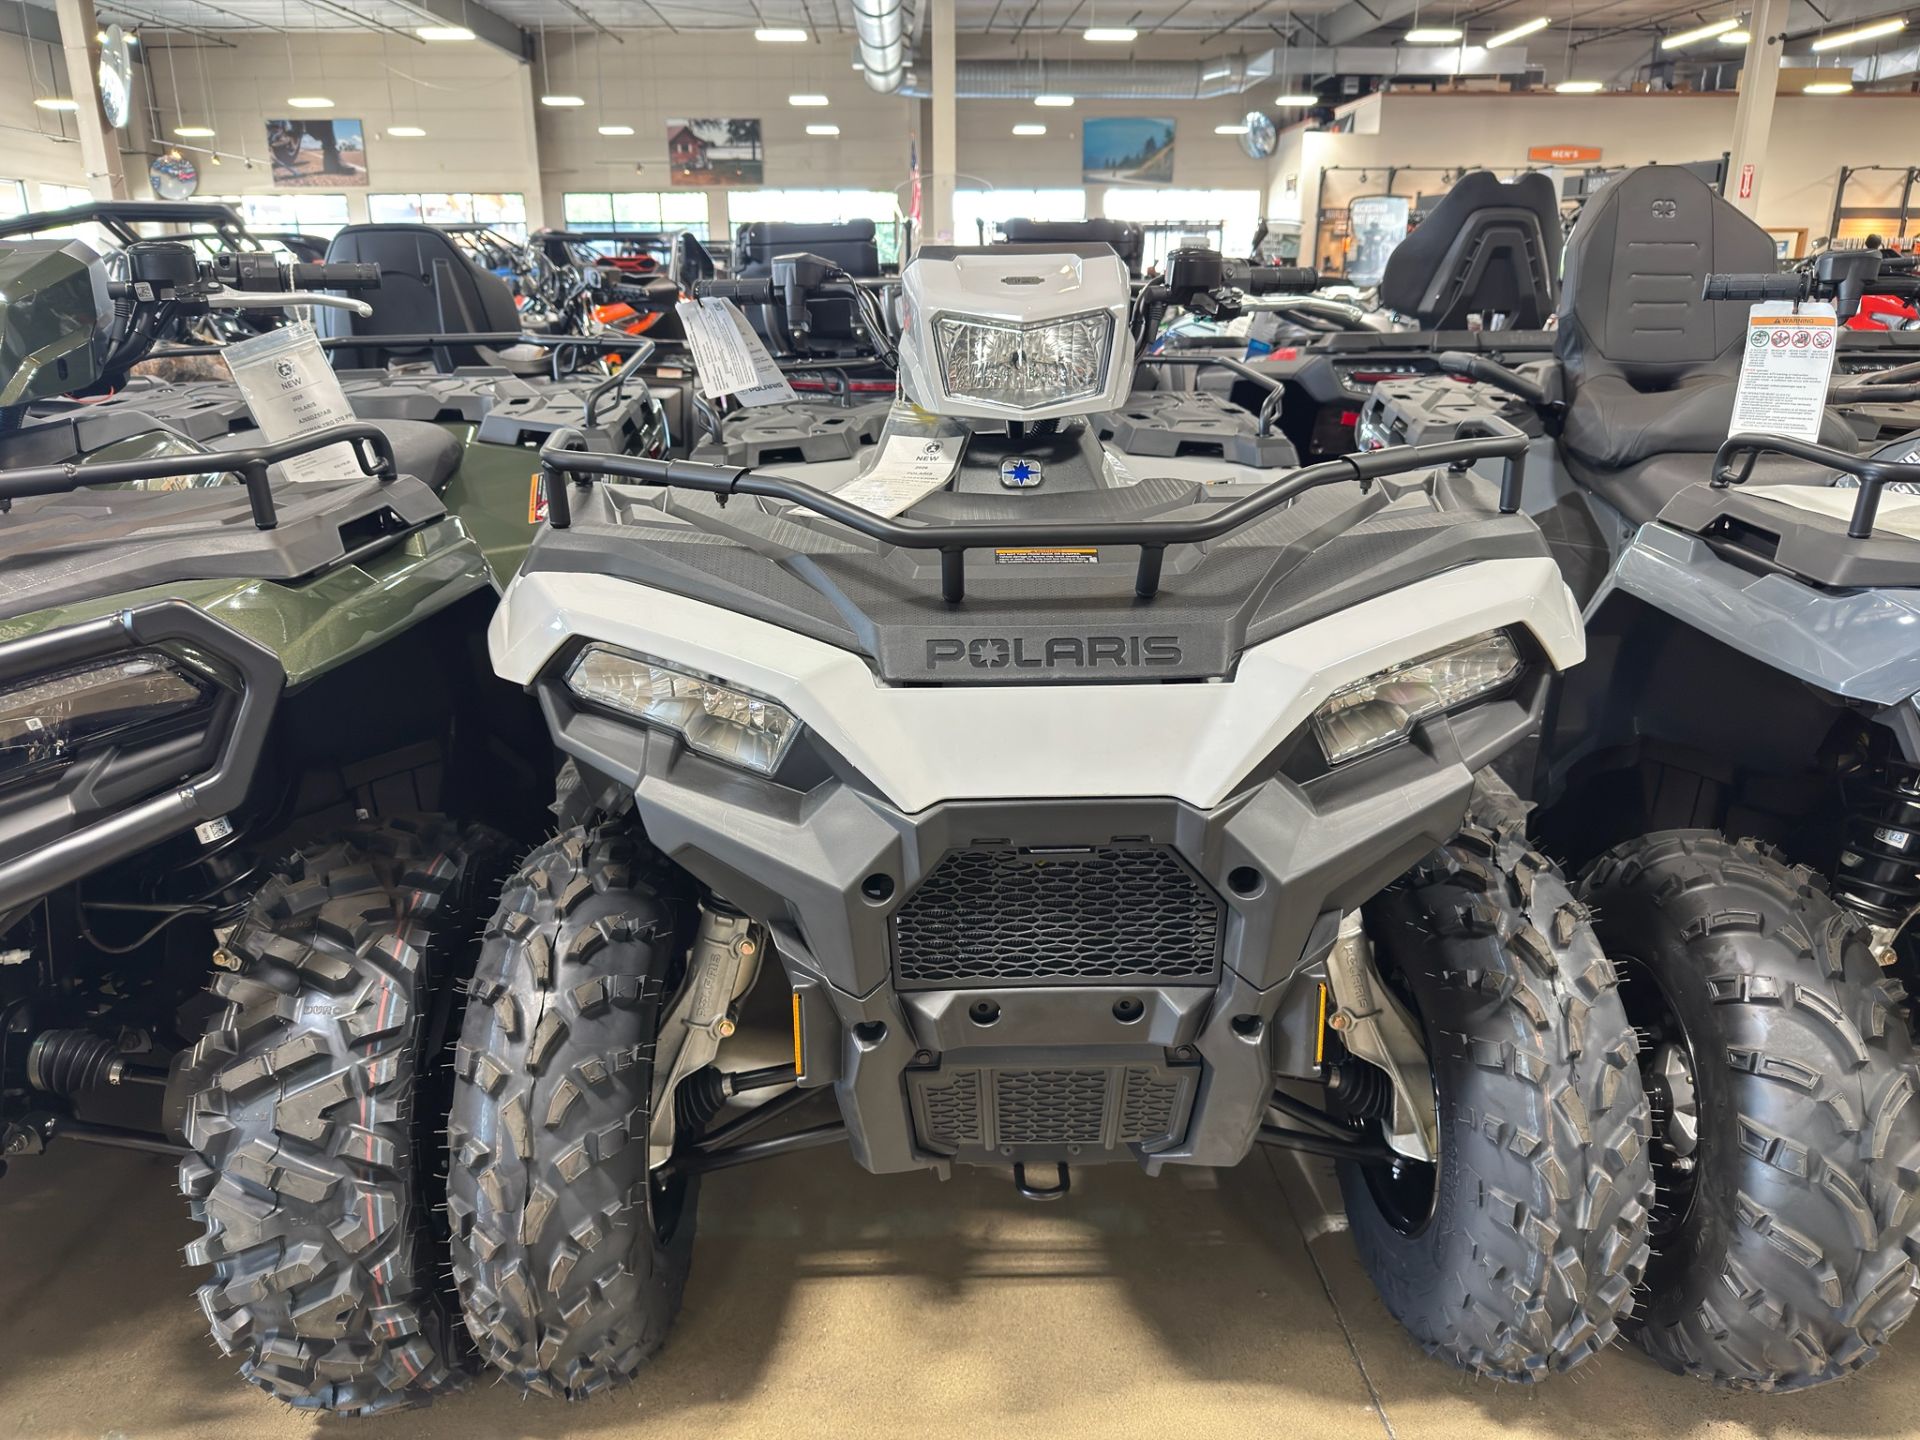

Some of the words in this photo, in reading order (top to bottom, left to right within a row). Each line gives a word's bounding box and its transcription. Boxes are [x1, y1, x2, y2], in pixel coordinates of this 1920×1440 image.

[1782, 317, 1814, 325] WARNING
[281, 377, 302, 390] NEW
[748, 382, 784, 393] POLARIS
[293, 401, 317, 413] POLARIS
[926, 635, 1183, 670] POLARIS
[1344, 944, 1369, 1009] POLARIS
[696, 953, 721, 1017] POLARIS
[303, 1005, 343, 1016] DURO
